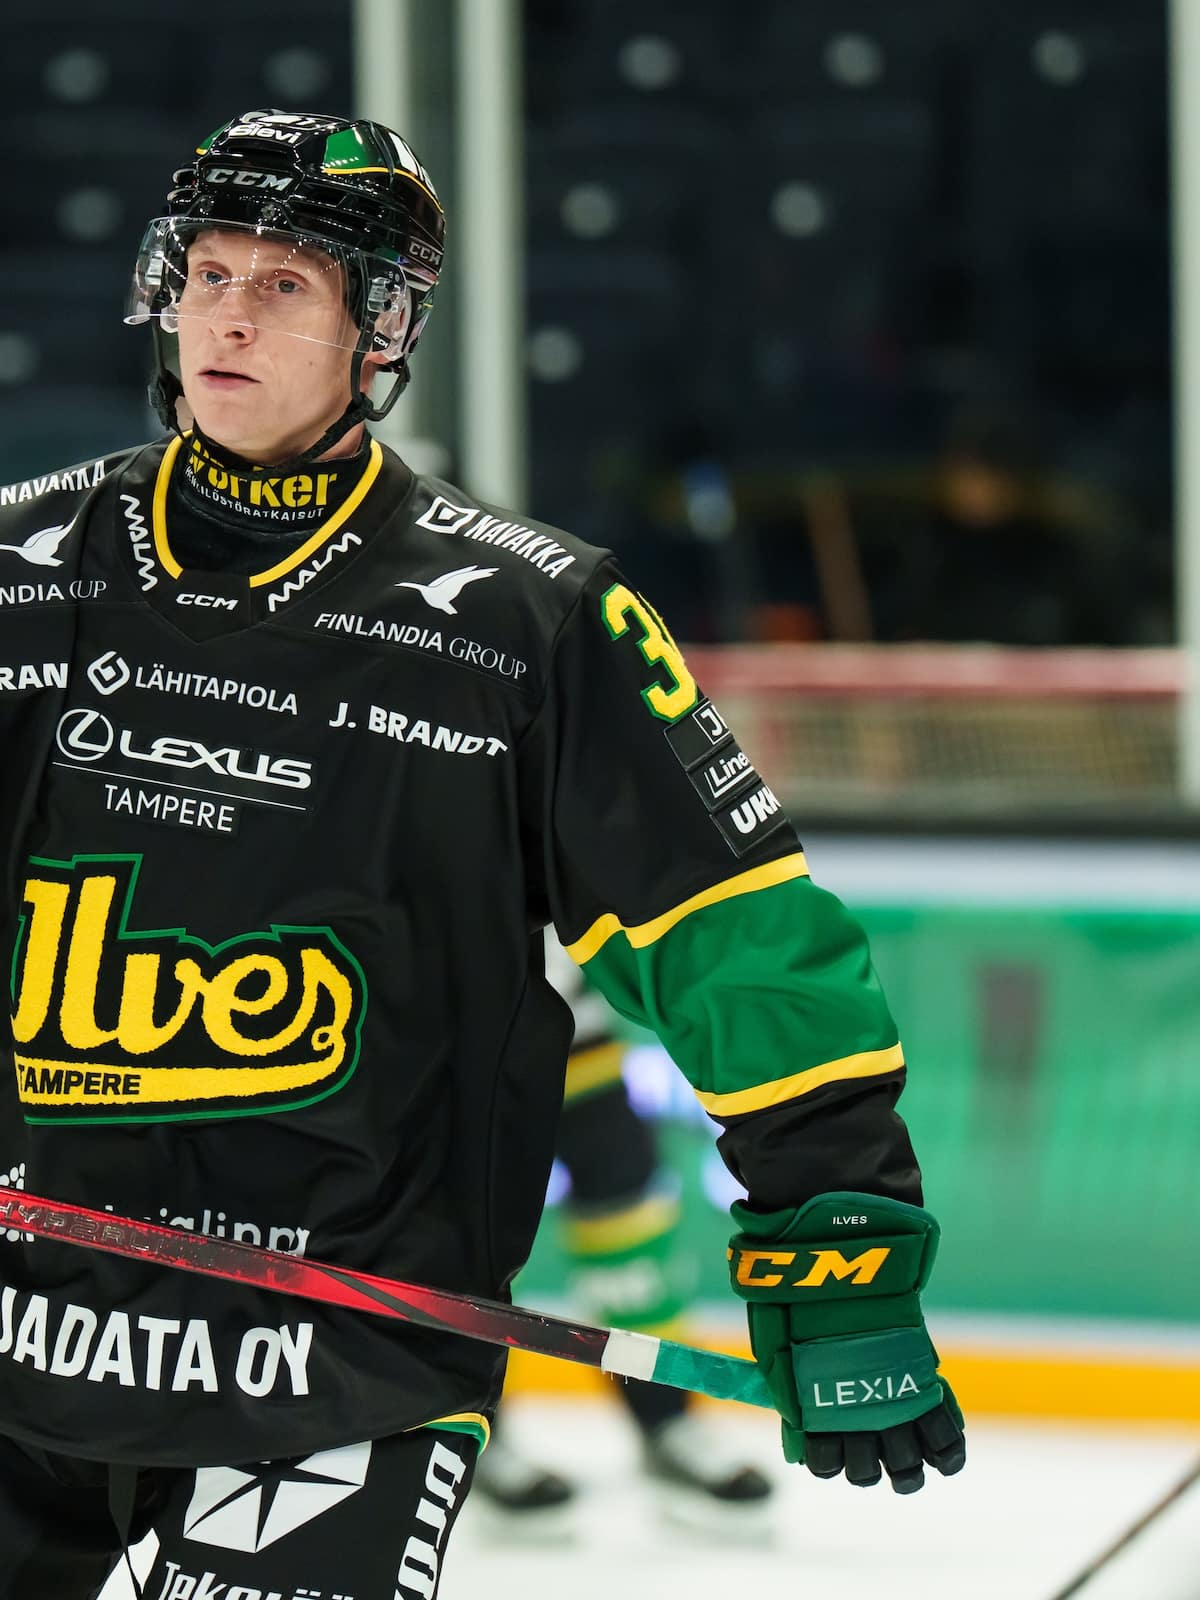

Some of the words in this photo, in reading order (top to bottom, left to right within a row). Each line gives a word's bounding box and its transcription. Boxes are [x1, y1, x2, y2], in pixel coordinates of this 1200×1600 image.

[205, 167, 294, 192] CCM
[409, 242, 441, 265] CCM
[464, 514, 577, 580] NAVAKKA
[176, 592, 239, 611] CCM
[313, 612, 444, 653] FINLANDIA
[449, 636, 528, 680] GROUP
[601, 582, 704, 723] 3
[134, 663, 299, 716] LÄHITAPIOLA
[328, 702, 357, 729] J.
[367, 704, 509, 759] BRANDT
[119, 729, 313, 790] LEXUS
[104, 783, 236, 833] TAMPERE
[10, 874, 354, 1057] Ilves
[832, 1215, 868, 1225] ILVES
[726, 1246, 892, 1287] CM
[234, 1321, 314, 1398] OY
[813, 1372, 921, 1408] LEXIA
